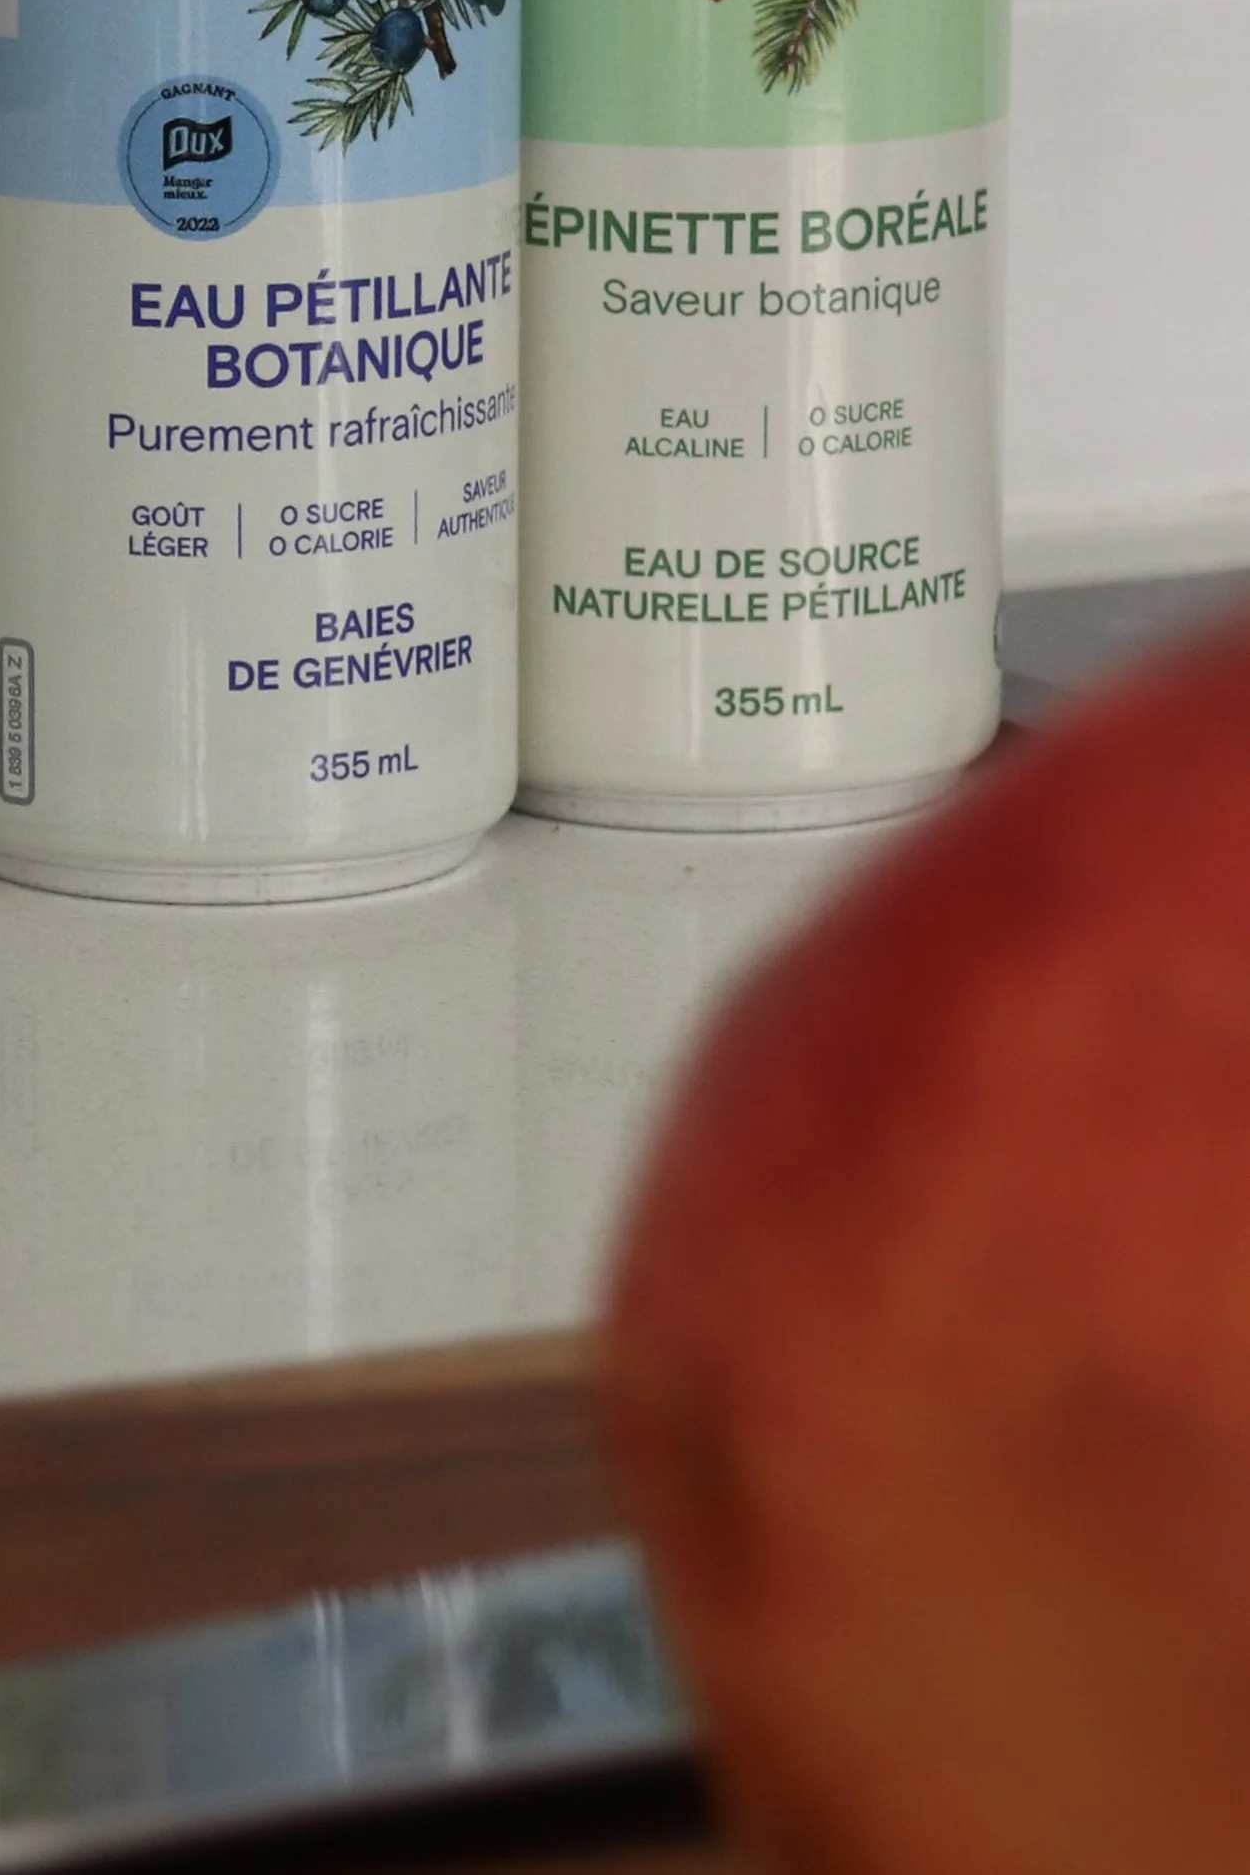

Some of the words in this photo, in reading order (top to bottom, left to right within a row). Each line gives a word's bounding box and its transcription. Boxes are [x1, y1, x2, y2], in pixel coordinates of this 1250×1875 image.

[161, 83, 236, 102] GAGNANT
[176, 217, 220, 232] 2022
[525, 191, 780, 255] ÉPINETTE
[801, 188, 988, 253] BORÉALE
[131, 283, 245, 329] EAU
[266, 249, 512, 327] PÉTILLANTE
[602, 278, 744, 317] Saveur
[759, 276, 941, 317] botanique
[207, 320, 484, 390] BOTANIQUE
[108, 413, 315, 453] Purement
[329, 383, 516, 449] rafraîchissante
[660, 408, 709, 429] EAU
[833, 398, 905, 424] SUCRE
[624, 436, 745, 458] ALCALINE
[823, 426, 913, 456] CALORIE
[463, 469, 507, 503] SAVEUR
[131, 501, 206, 527] GOÛT
[306, 498, 385, 524] SUCRE
[128, 532, 209, 558] LÉGER
[294, 527, 394, 555] CALORIE
[624, 546, 701, 579] EAU
[715, 549, 765, 579] DE
[779, 535, 920, 577] SOURCE
[553, 584, 768, 623] NATURELLE
[782, 568, 966, 621] PÉTILLANTE
[315, 602, 414, 643] BAIES
[228, 659, 280, 692] DE
[293, 634, 473, 690] GENÉVRIER
[714, 686, 785, 718] 355
[792, 684, 844, 714] mL
[310, 750, 371, 782] 355
[378, 744, 419, 775] mL
